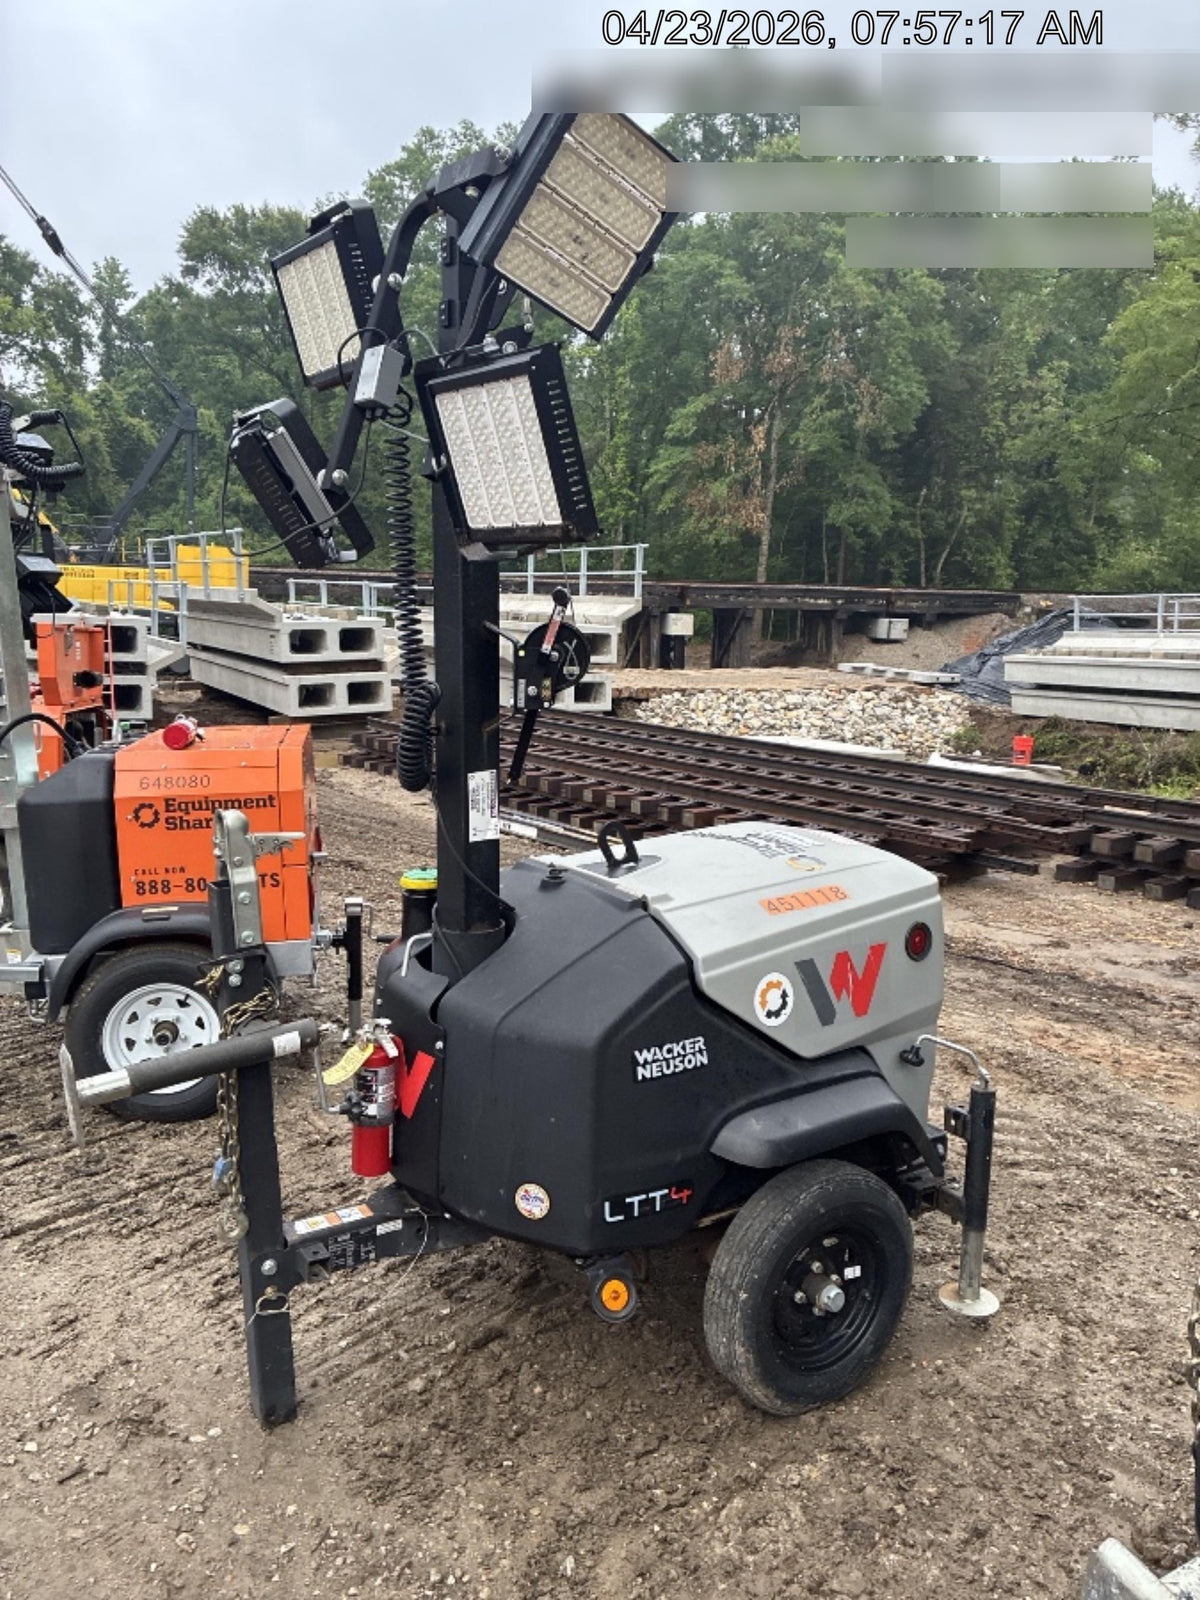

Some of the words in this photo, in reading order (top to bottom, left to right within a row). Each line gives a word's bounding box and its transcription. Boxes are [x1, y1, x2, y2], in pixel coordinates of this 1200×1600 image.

[139, 775, 211, 790] 648080
[164, 794, 277, 815] Equipment
[165, 815, 214, 831] Shar
[766, 885, 847, 913] 451118
[634, 1036, 706, 1065] WACKER
[636, 1050, 709, 1081] NEUSON
[604, 1187, 693, 1222] LTT4
